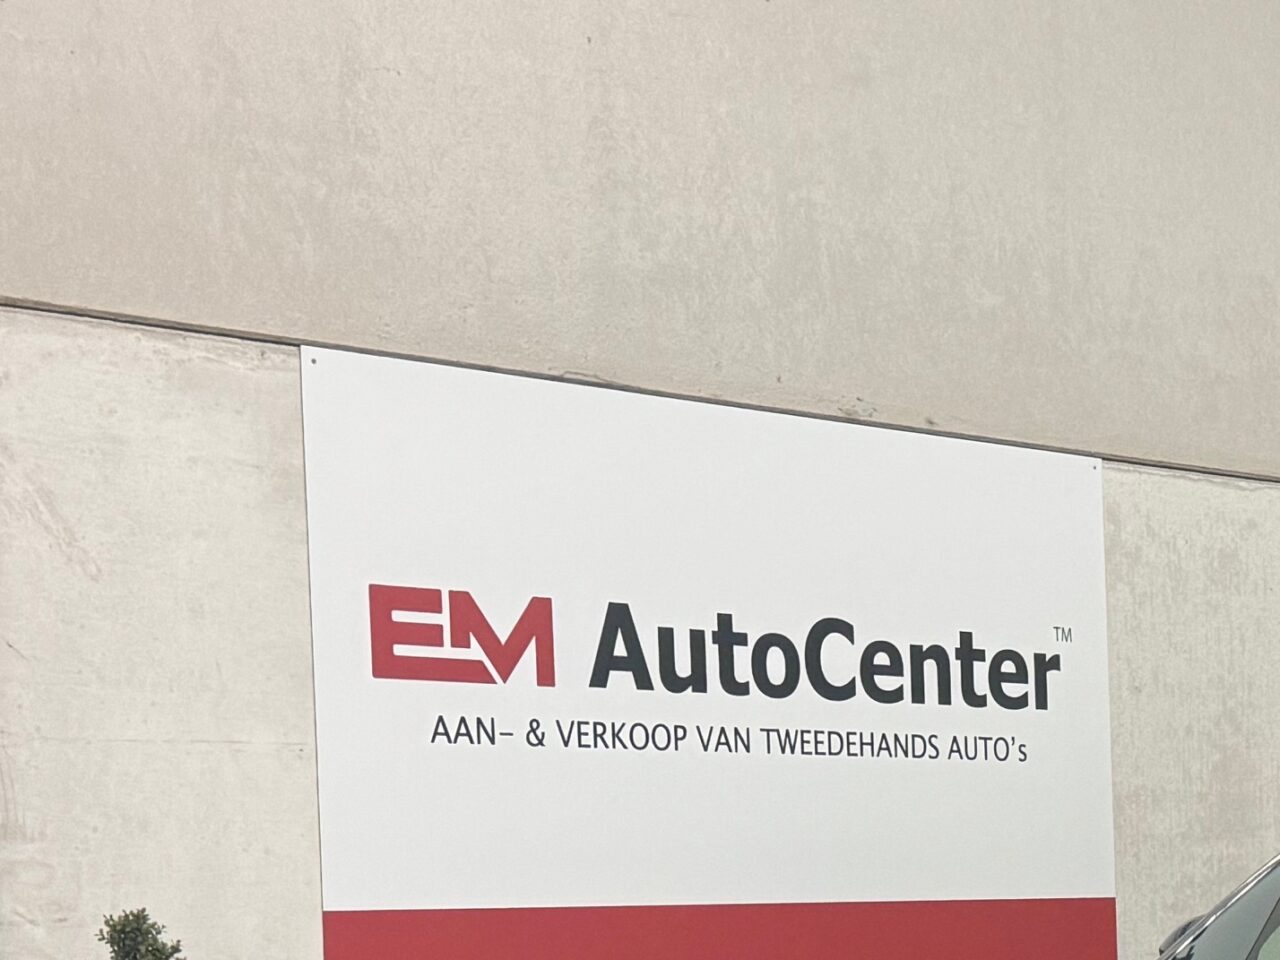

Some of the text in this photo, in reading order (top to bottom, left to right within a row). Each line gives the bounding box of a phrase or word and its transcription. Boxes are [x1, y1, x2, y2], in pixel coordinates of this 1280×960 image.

[370, 585, 556, 687] EM
[588, 602, 1061, 711] AutoCenter
[525, 719, 546, 747] &
[556, 720, 688, 752] VERKOOP
[696, 726, 751, 754] VAN
[760, 729, 940, 760] TWEEDEHANDS
[947, 735, 1028, 763] AUTO's
